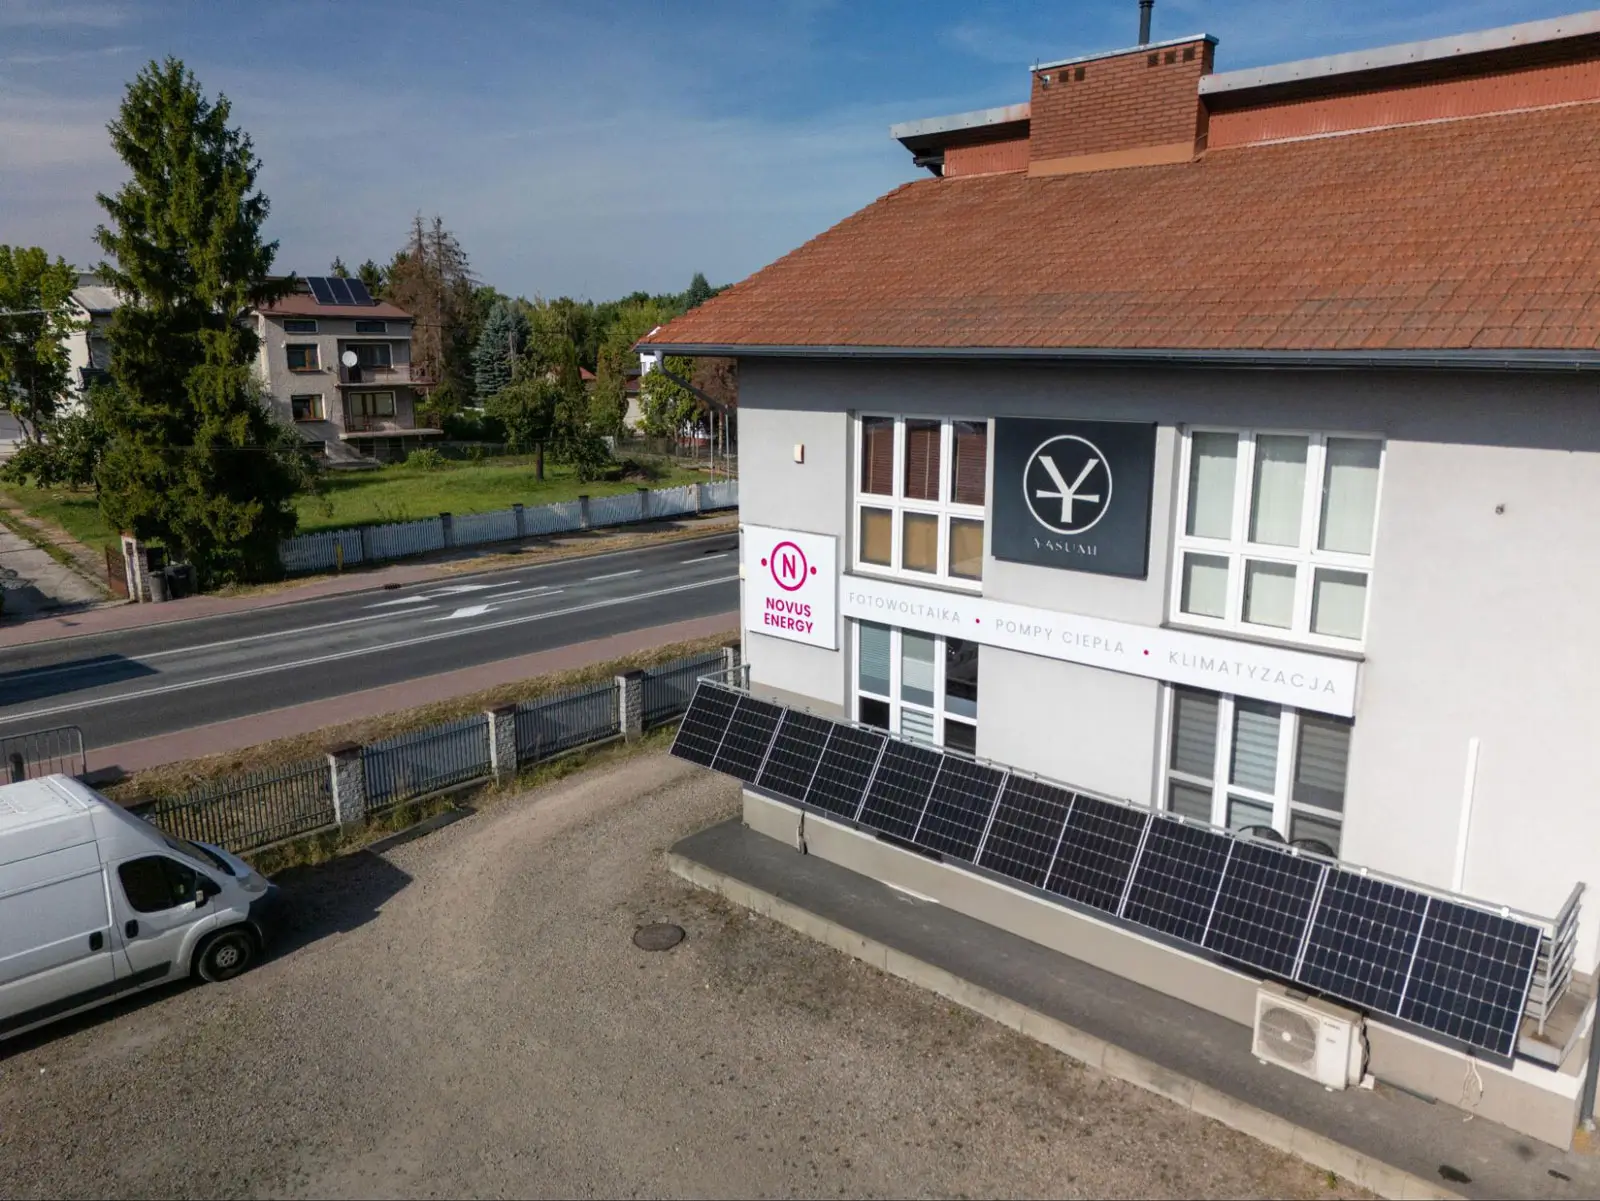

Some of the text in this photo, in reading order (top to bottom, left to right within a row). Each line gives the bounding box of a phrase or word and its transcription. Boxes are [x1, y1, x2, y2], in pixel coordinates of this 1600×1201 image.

[1033, 537, 1097, 556] YASUMI
[766, 597, 811, 618] NOVUS
[764, 612, 814, 634] ENERGY
[849, 592, 961, 624] FOTOWOLTAIKA
[995, 618, 1053, 641] POMPY
[1169, 650, 1336, 694] KLIMATYZACJA
